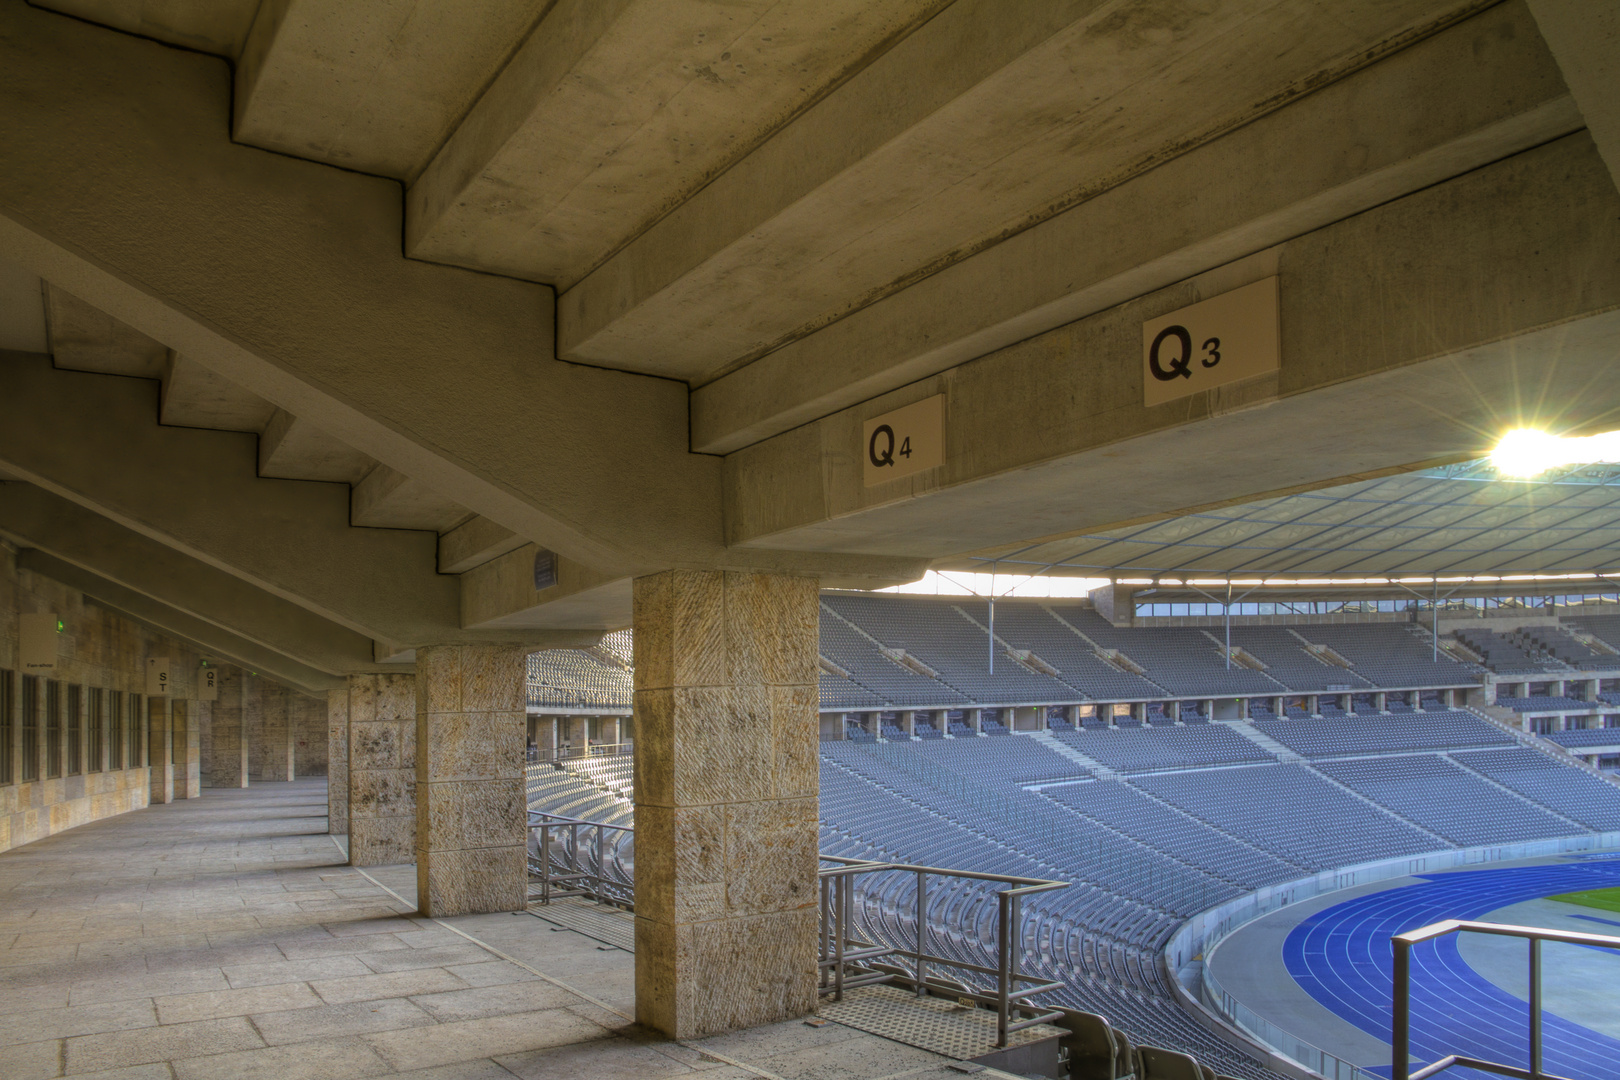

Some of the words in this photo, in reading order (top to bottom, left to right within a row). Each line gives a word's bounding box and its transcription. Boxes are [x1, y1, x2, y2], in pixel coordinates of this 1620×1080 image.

[159, 672, 167, 681] S
[206, 671, 215, 680] Q
[159, 683, 167, 692] T
